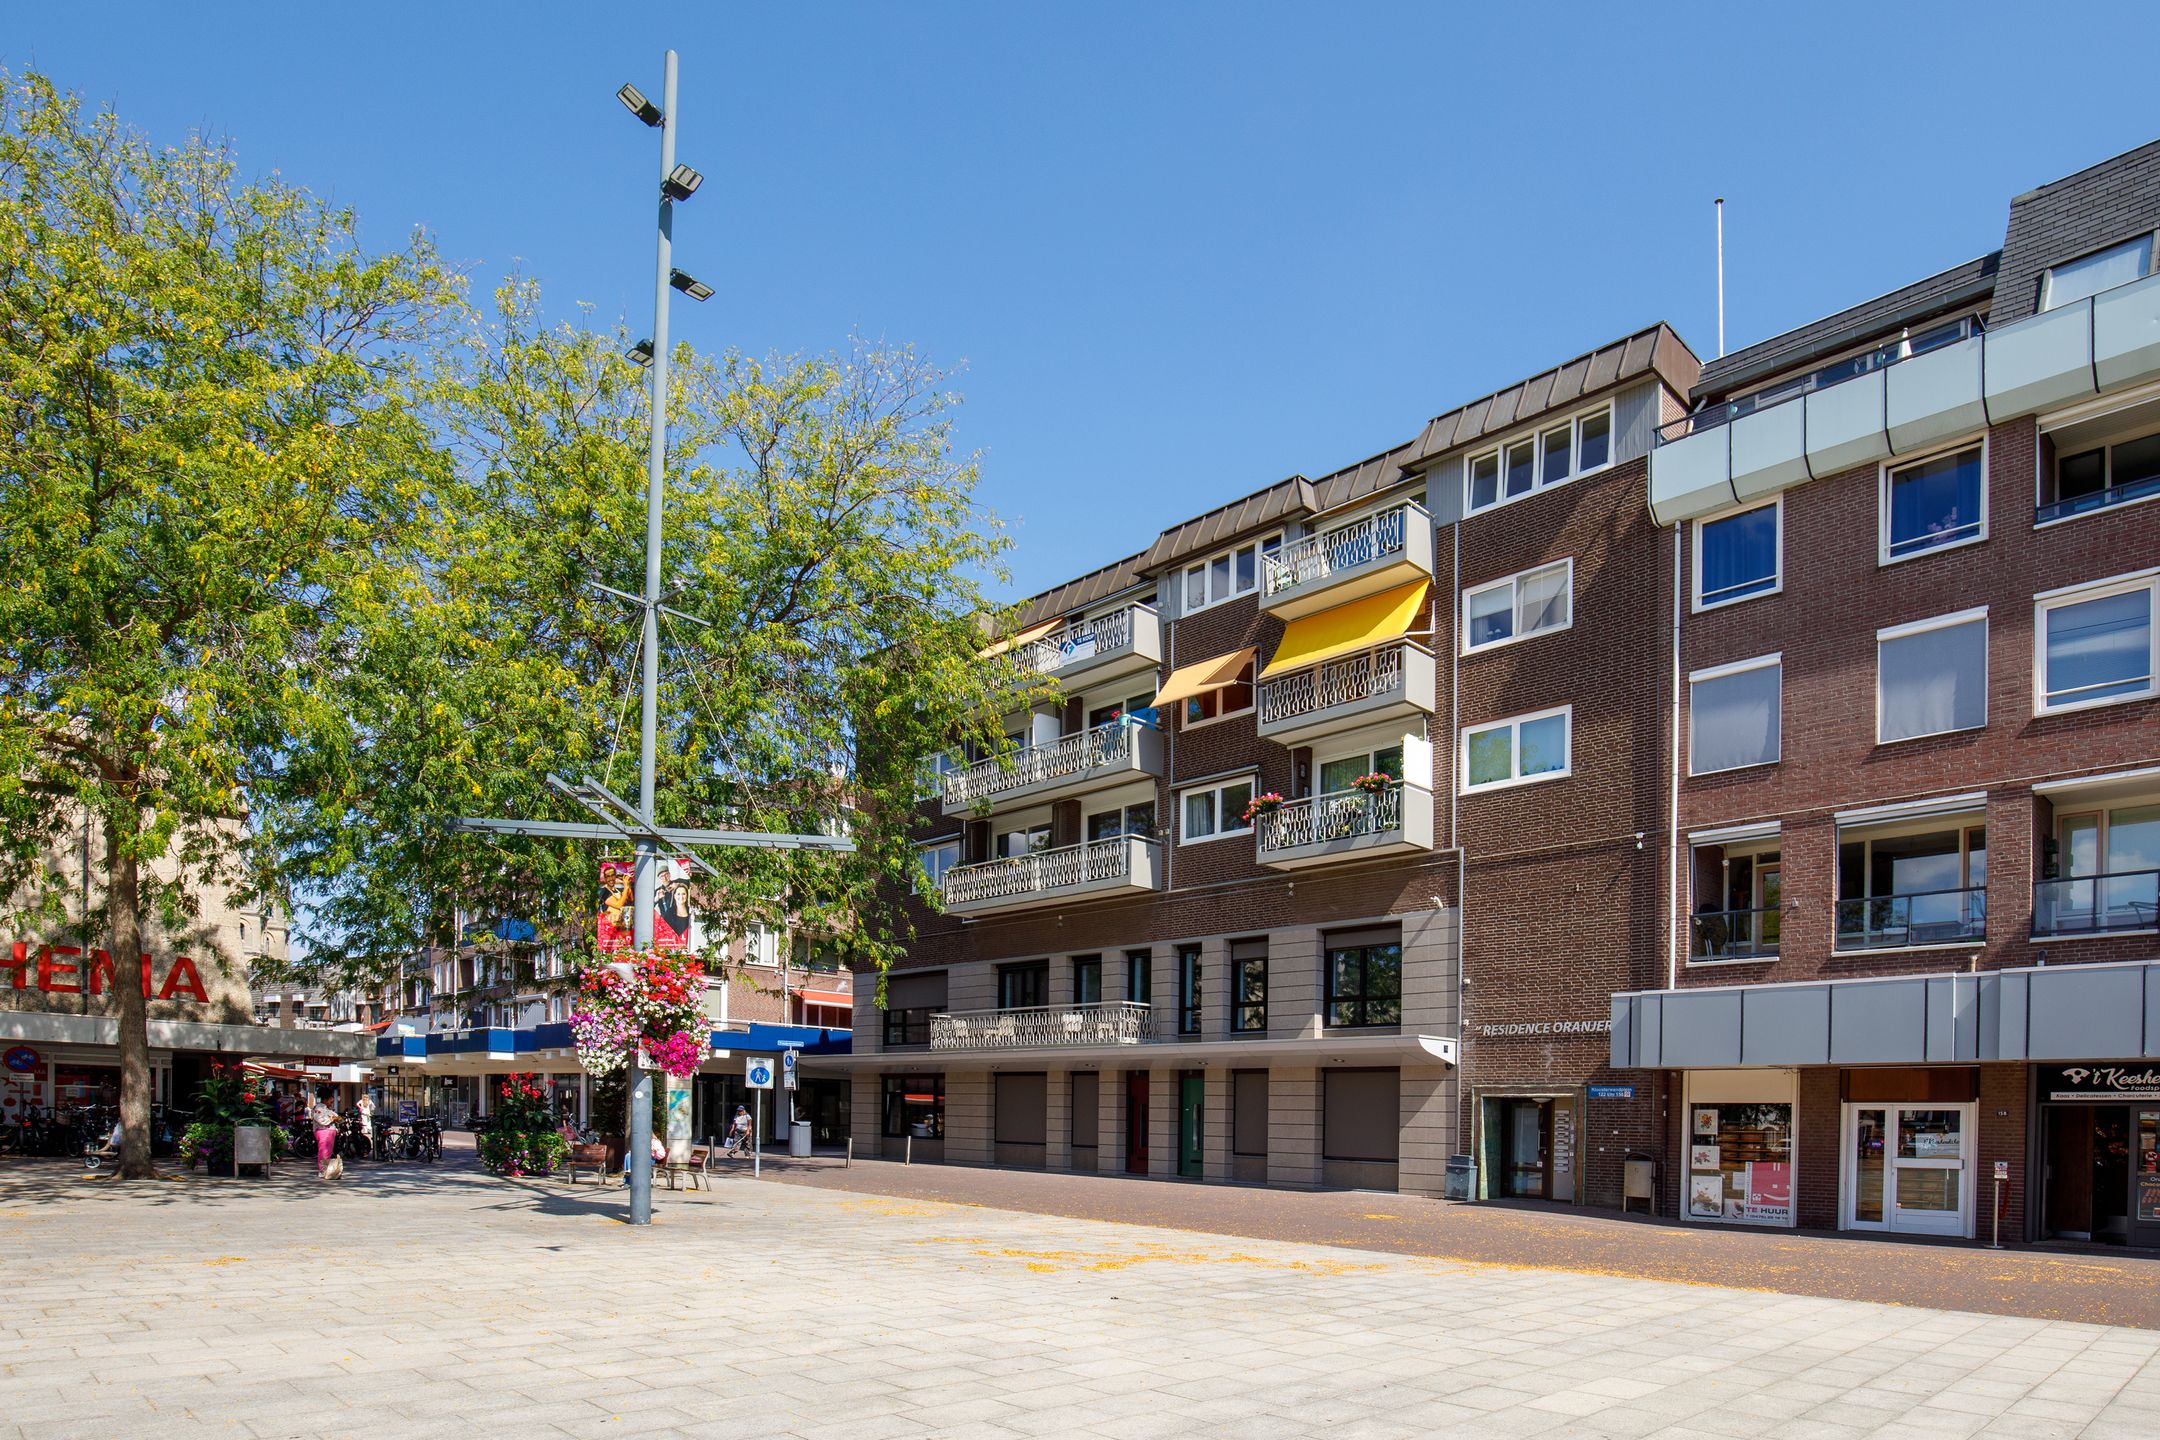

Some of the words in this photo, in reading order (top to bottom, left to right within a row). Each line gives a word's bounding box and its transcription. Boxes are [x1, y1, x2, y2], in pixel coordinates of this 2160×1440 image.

[1083, 634, 1095, 642] KOOP
[0, 942, 210, 1003] HEMA
[307, 1057, 331, 1065] HEMA
